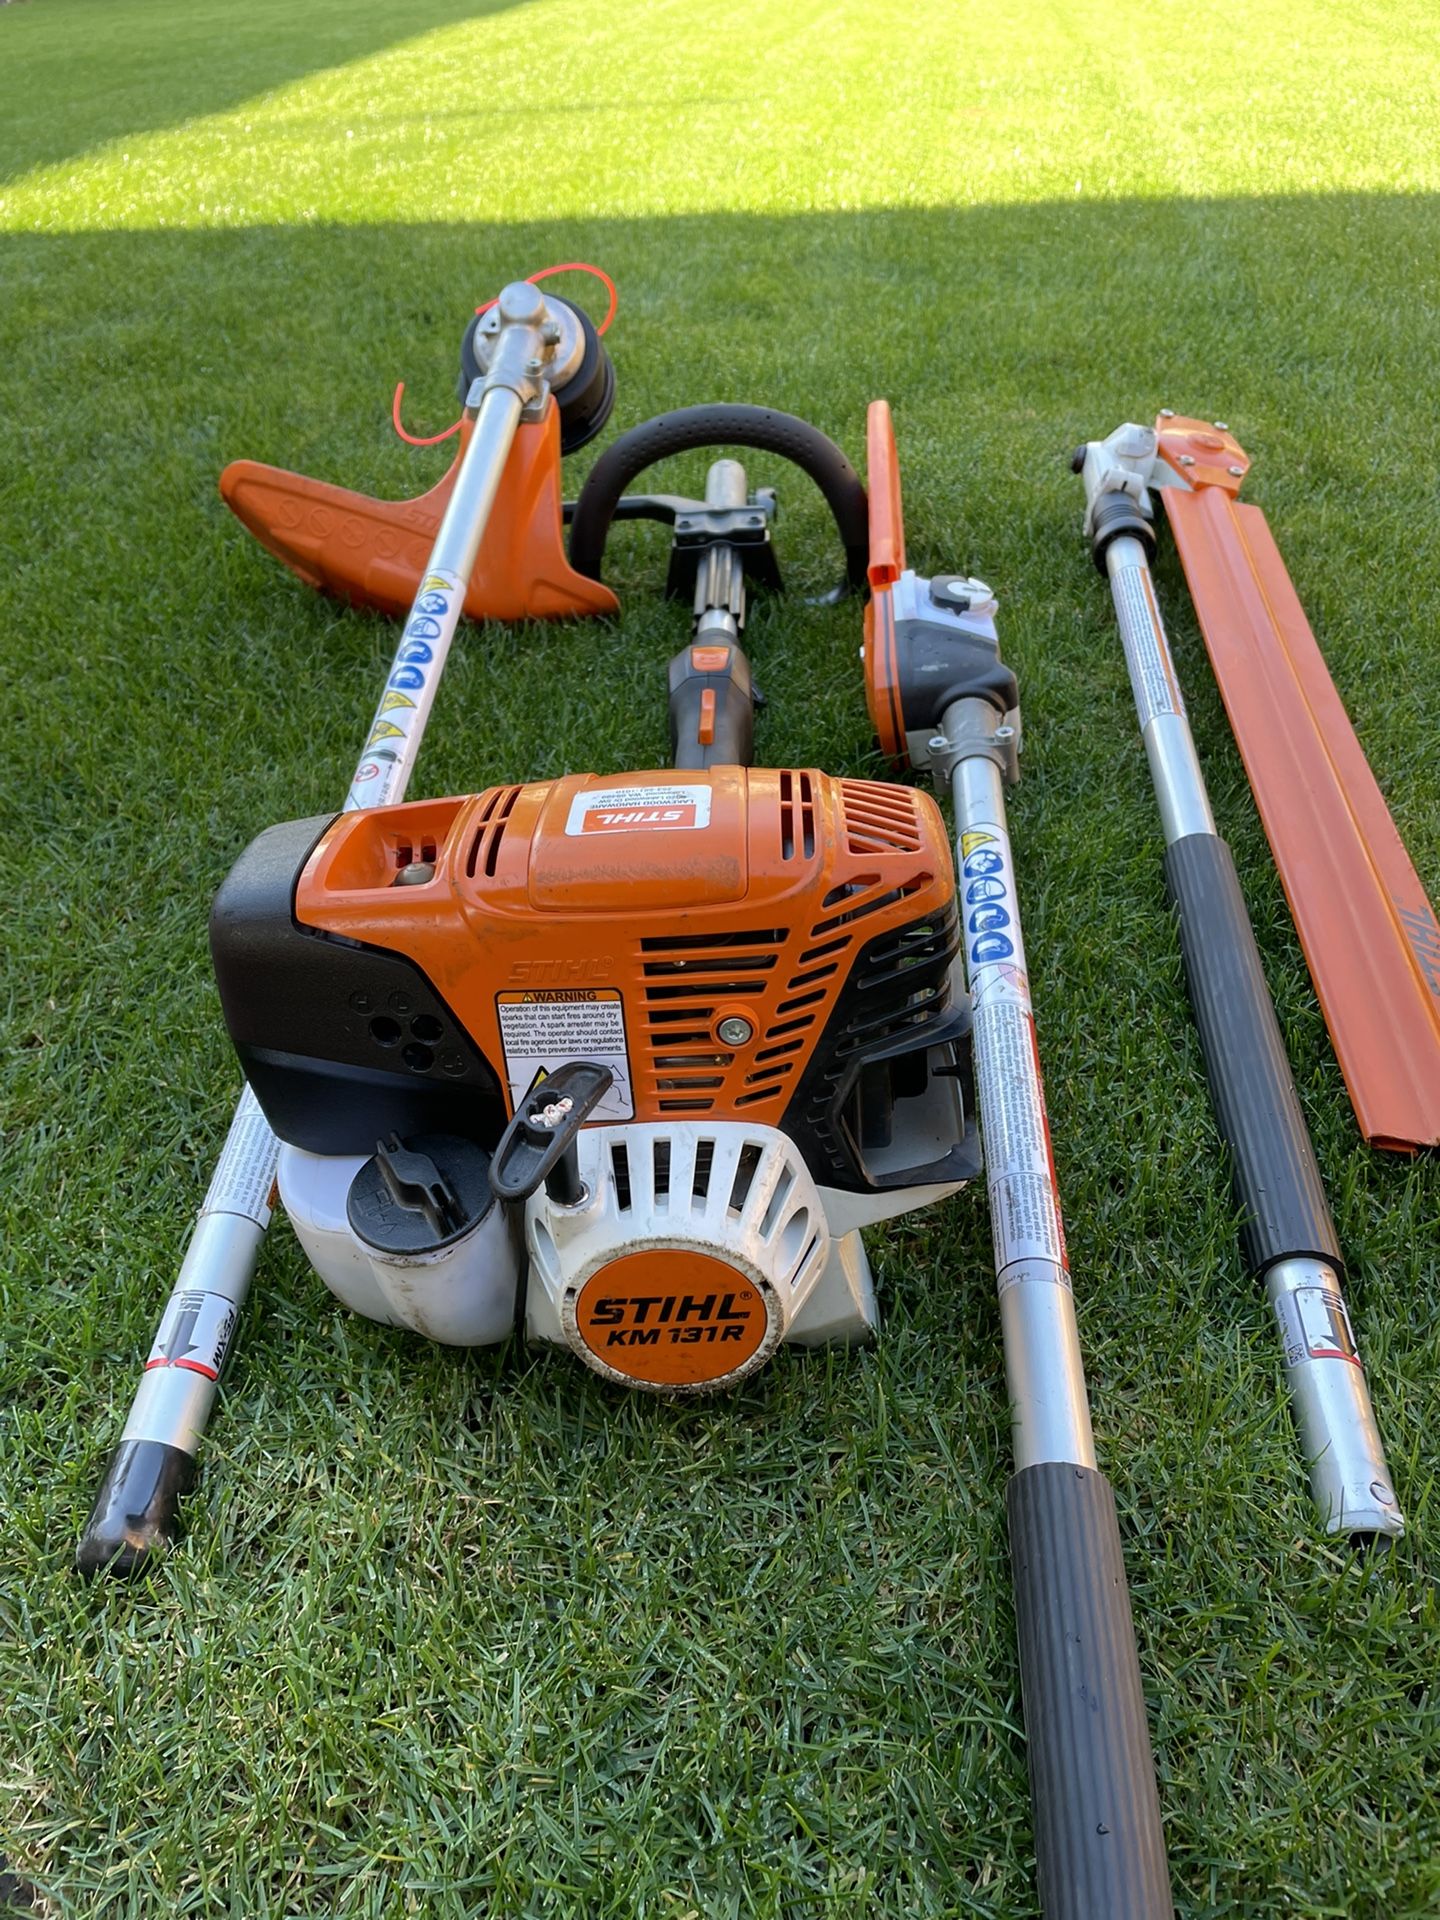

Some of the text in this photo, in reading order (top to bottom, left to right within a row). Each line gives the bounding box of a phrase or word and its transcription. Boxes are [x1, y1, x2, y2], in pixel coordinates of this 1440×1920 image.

[596, 809, 684, 824] STIHL
[533, 991, 596, 1002] WARNING
[500, 1005, 530, 1013] Operation
[551, 1003, 584, 1011] equipment
[501, 1014, 522, 1022] sparks
[606, 1010, 616, 1019] dry
[502, 1022, 537, 1031] vegetation.
[546, 1021, 564, 1030] spark
[504, 1030, 531, 1039] required.
[547, 1029, 574, 1037] operator
[531, 1038, 557, 1046] agencies
[590, 1035, 623, 1044] regulations
[506, 1047, 528, 1055] relating
[548, 1045, 579, 1054] prevention
[581, 1044, 622, 1053] requirements.
[589, 1293, 752, 1326] STIHL
[606, 1325, 746, 1347] KM 131R
